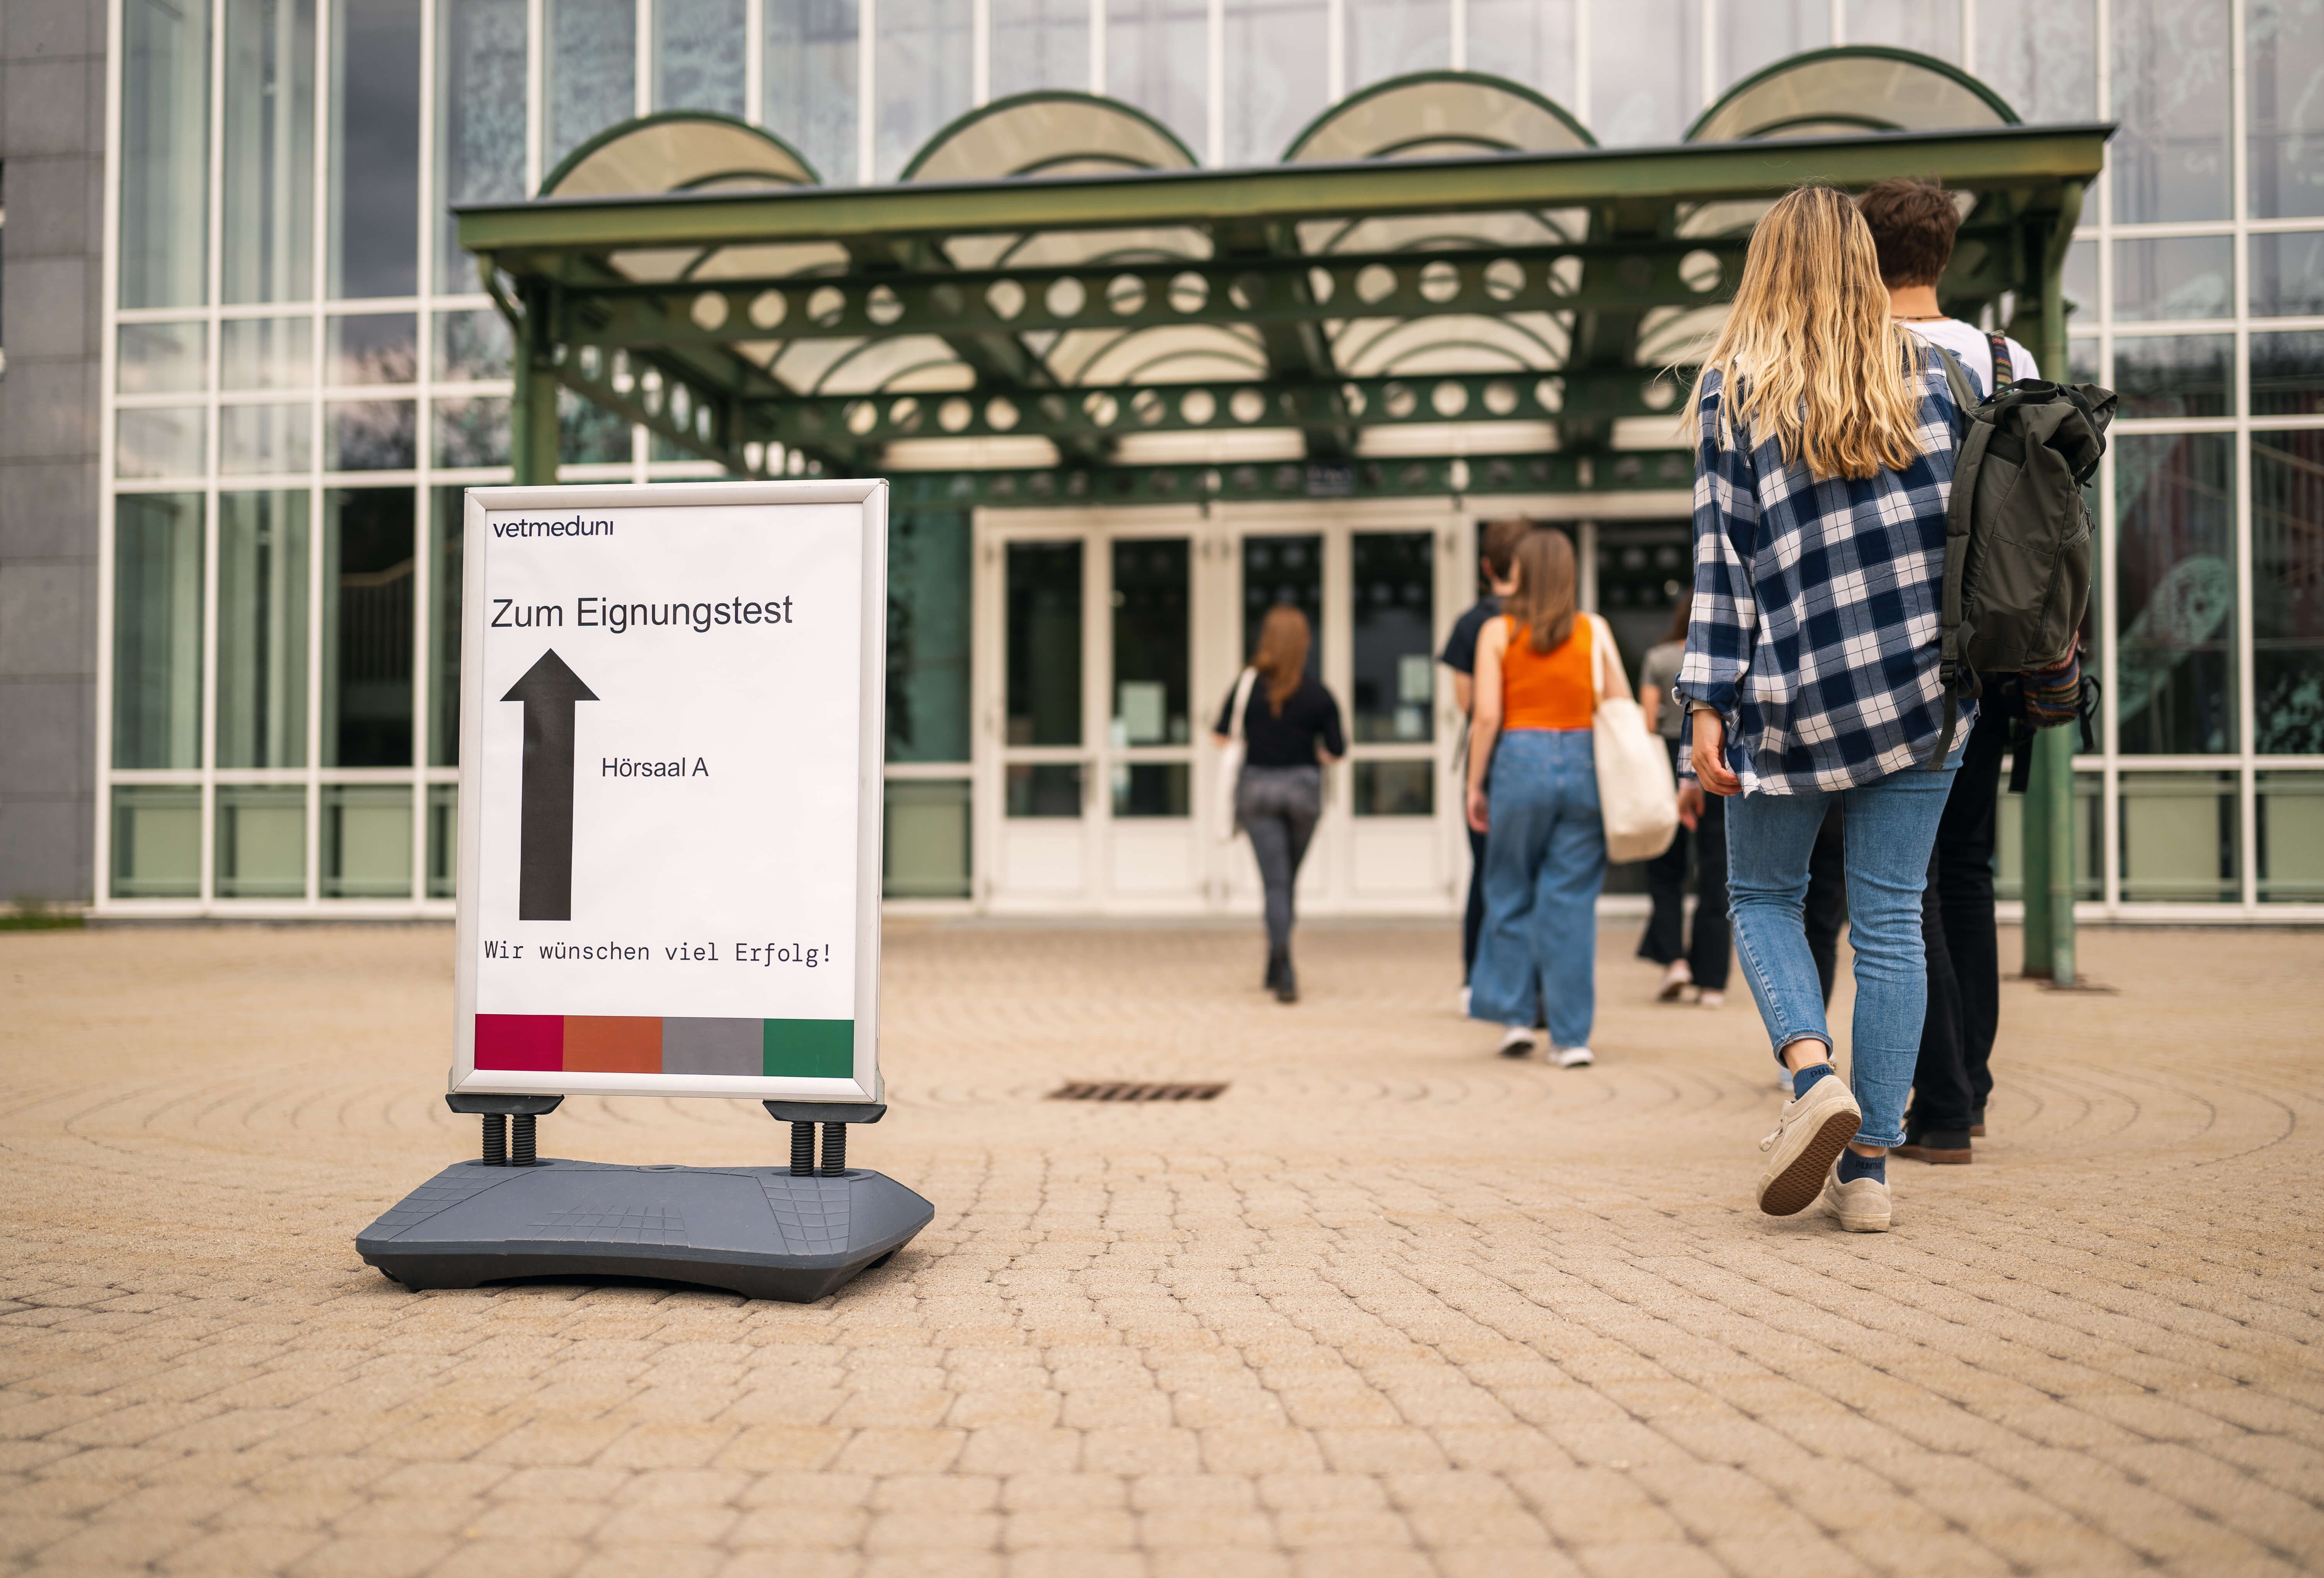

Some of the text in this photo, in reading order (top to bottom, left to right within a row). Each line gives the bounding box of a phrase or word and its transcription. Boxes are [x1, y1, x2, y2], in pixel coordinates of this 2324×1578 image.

[493, 515, 613, 538] vetmeduni
[491, 595, 793, 634] Zum Eignungstest
[603, 757, 709, 777] Hörsaal A
[484, 941, 829, 968] Wir wünschen viel Erfolg!
